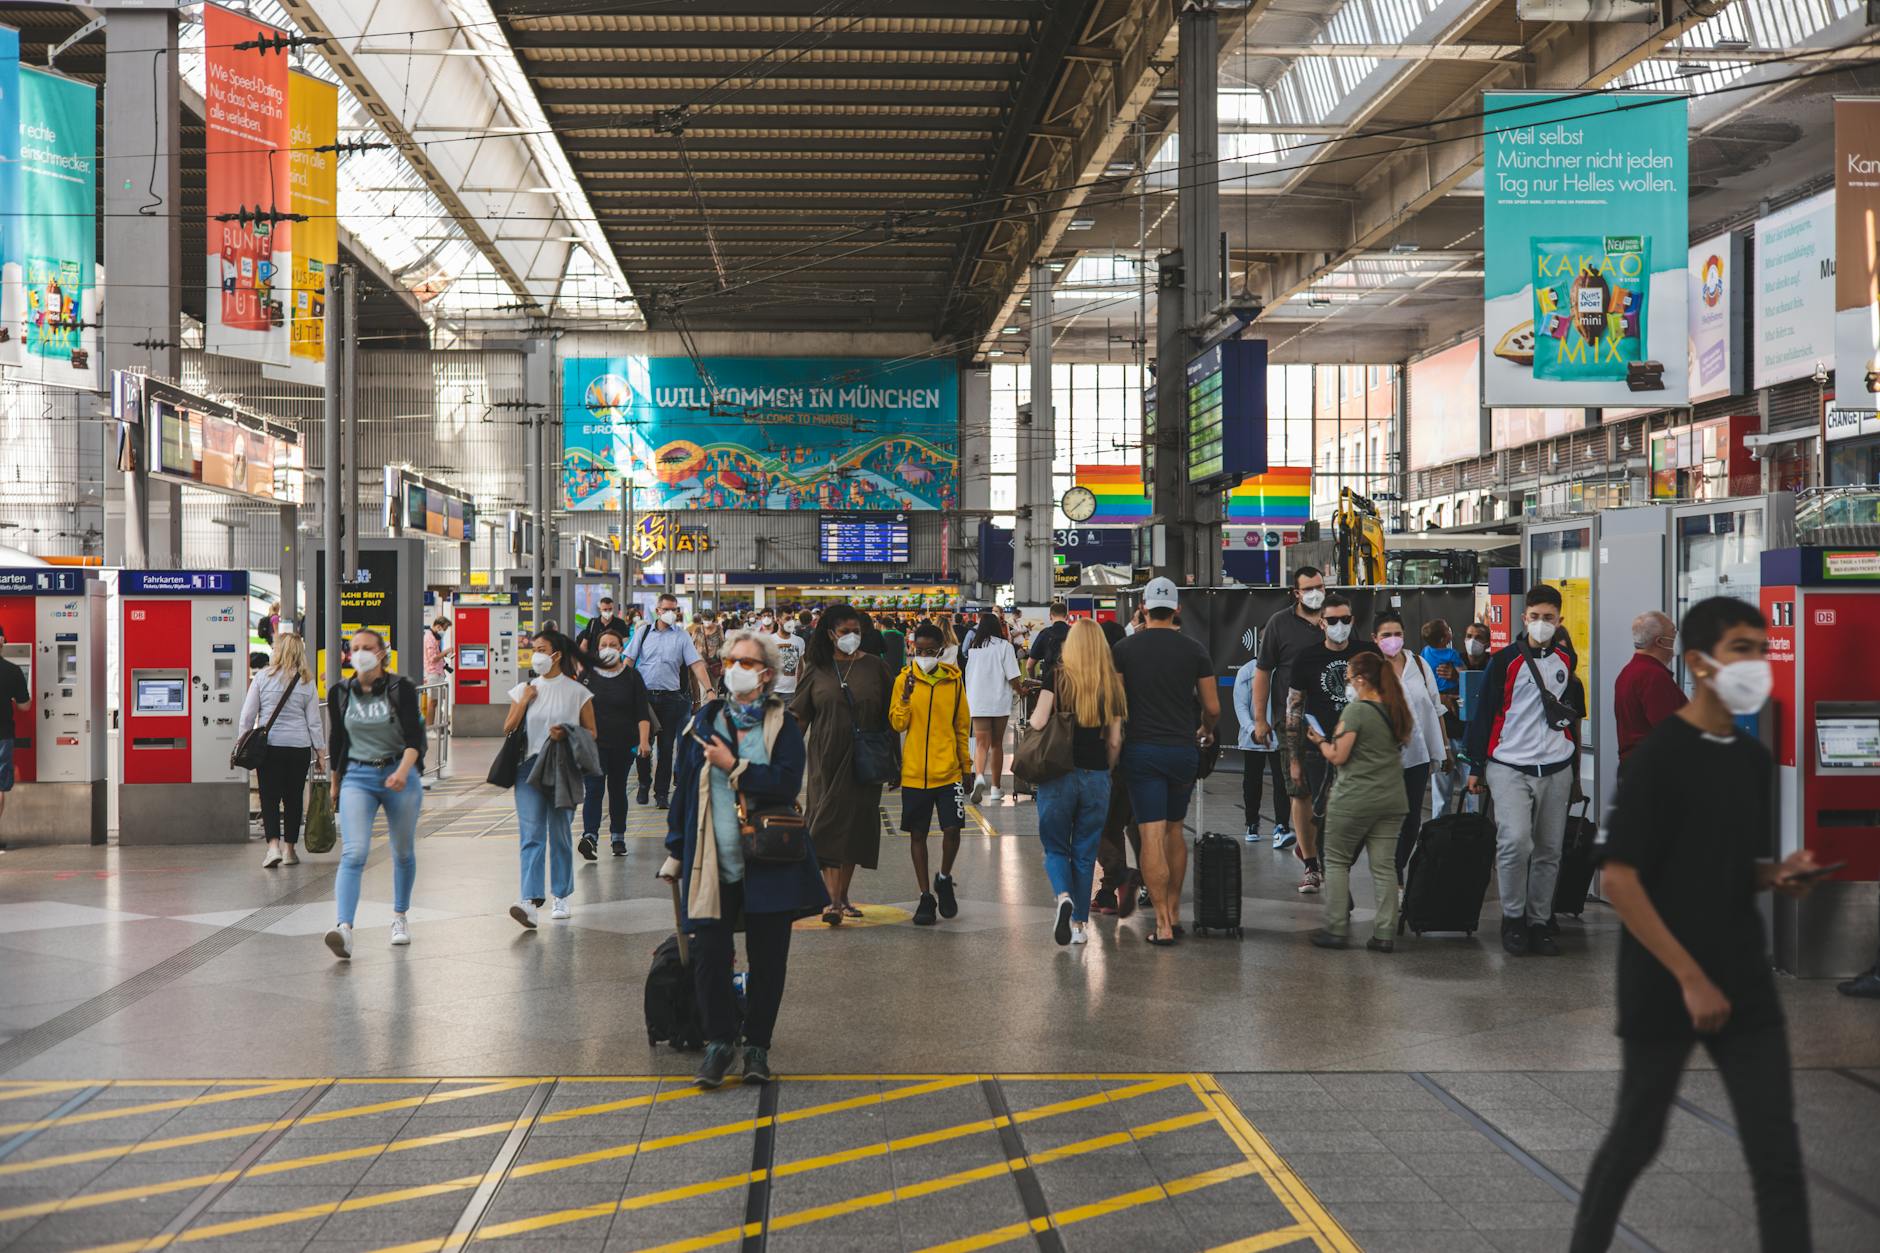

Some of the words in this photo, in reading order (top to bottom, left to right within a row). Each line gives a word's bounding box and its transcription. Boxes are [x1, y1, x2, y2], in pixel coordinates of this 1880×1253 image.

[209, 62, 228, 81] Wie
[210, 82, 226, 103] Nur,
[228, 88, 245, 107] dass
[247, 95, 259, 111] Sie
[261, 101, 274, 117] sich
[275, 105, 283, 119] in
[210, 103, 225, 119] alle
[226, 110, 262, 131] verlieben.
[28, 121, 56, 142] echte
[1496, 126, 1535, 145] Weil
[1539, 125, 1584, 145] selbst
[21, 145, 91, 174] einschmecker.
[310, 154, 326, 170] alle
[1497, 149, 1582, 168] Münchner
[1586, 148, 1622, 168] nicht
[1626, 148, 1673, 174] jeden
[1496, 173, 1529, 198] Tag
[1533, 180, 1558, 192] nur
[1563, 172, 1614, 192] Helles
[1618, 172, 1677, 192] wollen.
[224, 227, 270, 256] BUNTE
[1607, 240, 1623, 251] NEU
[1538, 254, 1642, 278] KAKAO
[225, 289, 268, 319] TÜTE
[1579, 315, 1602, 326] mini
[38, 327, 71, 348] MIX
[293, 323, 322, 345] ÜTE
[1557, 335, 1623, 364] MIX
[656, 387, 803, 408] WILLKOMMEN
[808, 387, 833, 408] IN
[839, 385, 940, 408] MÜNCHEN
[799, 413, 810, 425] TO
[812, 413, 853, 425] MUNICH
[1828, 411, 1857, 428] CHANGE
[143, 575, 184, 584] Fahrkarten
[1054, 574, 1079, 583] linger
[363, 591, 384, 599] SEITE
[1818, 612, 1833, 623] DB
